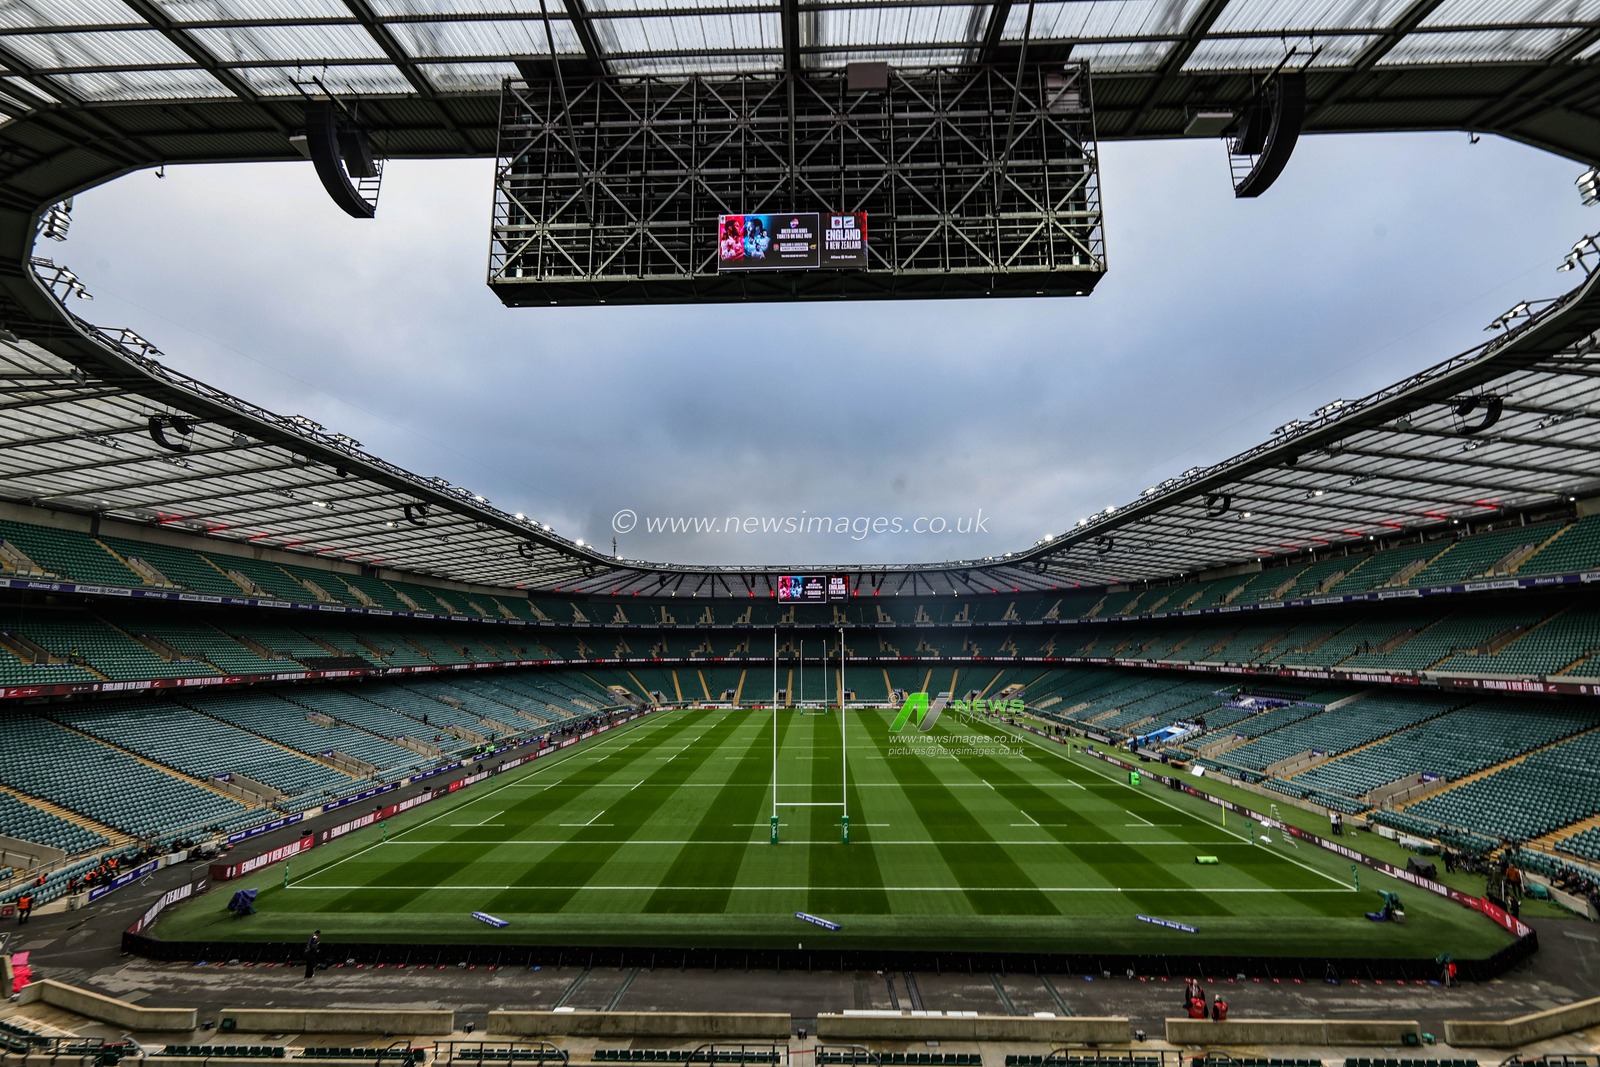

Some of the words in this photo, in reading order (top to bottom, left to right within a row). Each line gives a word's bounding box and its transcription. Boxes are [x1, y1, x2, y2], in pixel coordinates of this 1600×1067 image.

[826, 229, 861, 241] ENGLAND
[825, 241, 830, 250] V
[830, 241, 841, 250] NEW
[841, 241, 862, 250] ZEALAND
[102, 682, 123, 692] ENGLAND
[136, 681, 151, 689] ZEALAND
[1483, 680, 1508, 690] ENGLAND
[1512, 682, 1522, 691] NEW
[1523, 682, 1544, 692] ZEALAND
[331, 822, 350, 838] ENGLAND
[353, 818, 361, 829] NEW
[361, 813, 375, 826] ZEALAND
[1321, 838, 1338, 852] ENGLAND
[241, 854, 268, 874] ENGLAND
[267, 851, 272, 863] V
[272, 848, 282, 861] NEW
[282, 841, 301, 857] ZEALAND
[1393, 867, 1415, 883] ENGLAND
[1419, 877, 1428, 889] NEW
[1428, 880, 1448, 896] ZEALAND
[92, 887, 105, 897] Allianz
[165, 883, 192, 905] ZEALAND
